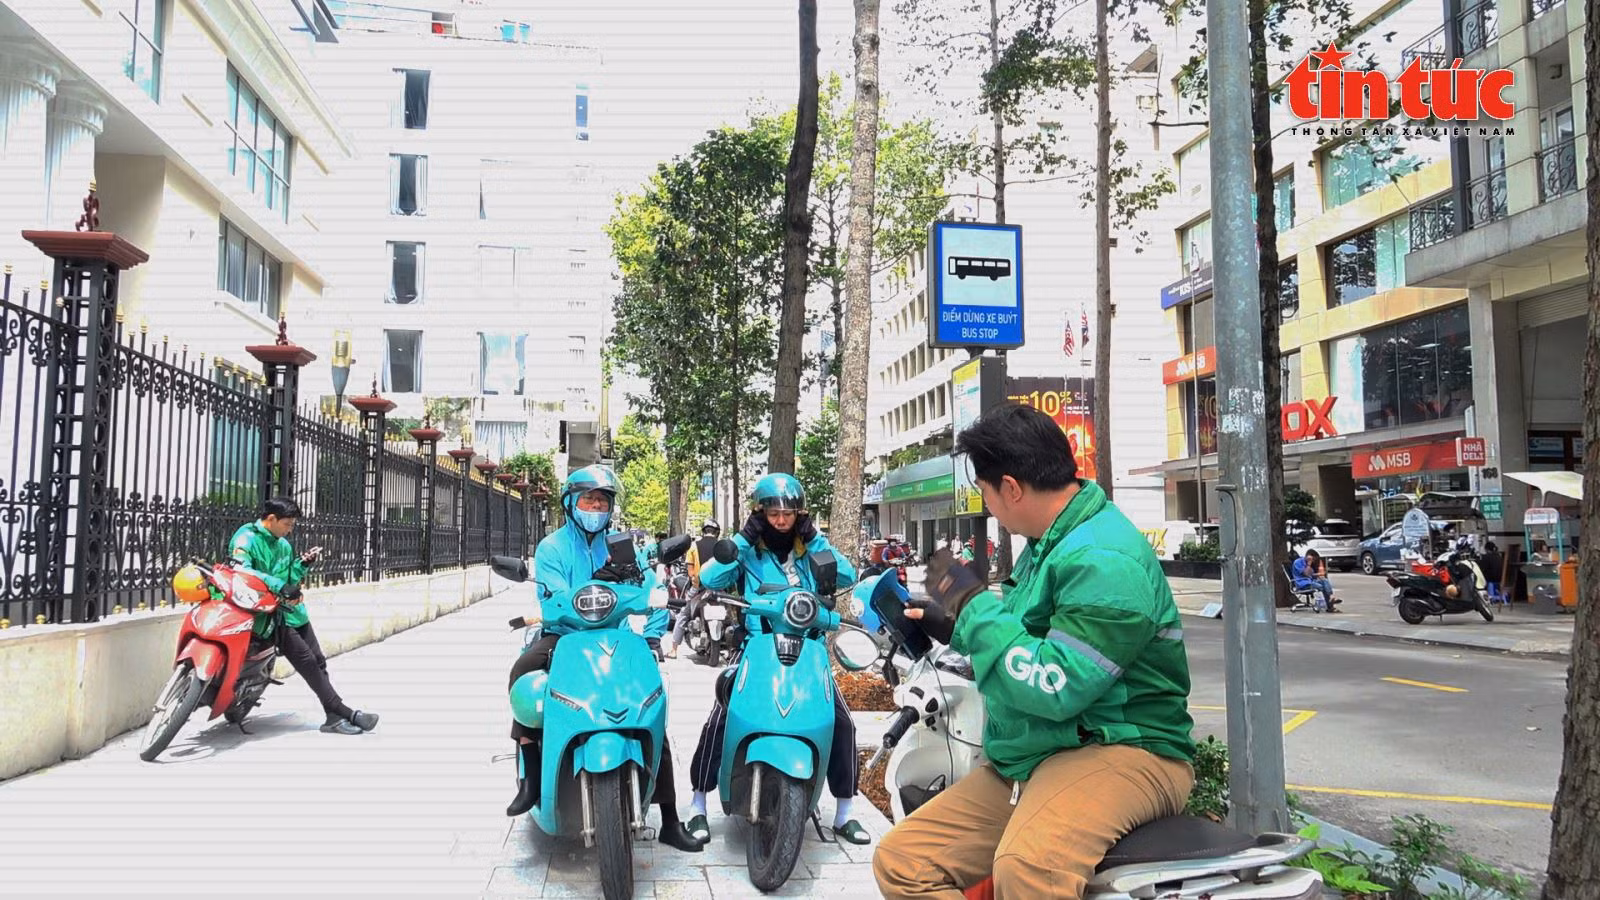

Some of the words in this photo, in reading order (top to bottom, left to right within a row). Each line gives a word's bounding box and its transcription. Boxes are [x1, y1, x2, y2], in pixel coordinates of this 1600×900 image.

[943, 307, 961, 322] ĐIỂM
[986, 312, 997, 324] XE
[961, 327, 978, 339] BUS
[979, 328, 999, 340] STOP
[1030, 391, 1072, 416] 10%
[1386, 452, 1411, 469] MSB
[1463, 452, 1485, 461] DELI
